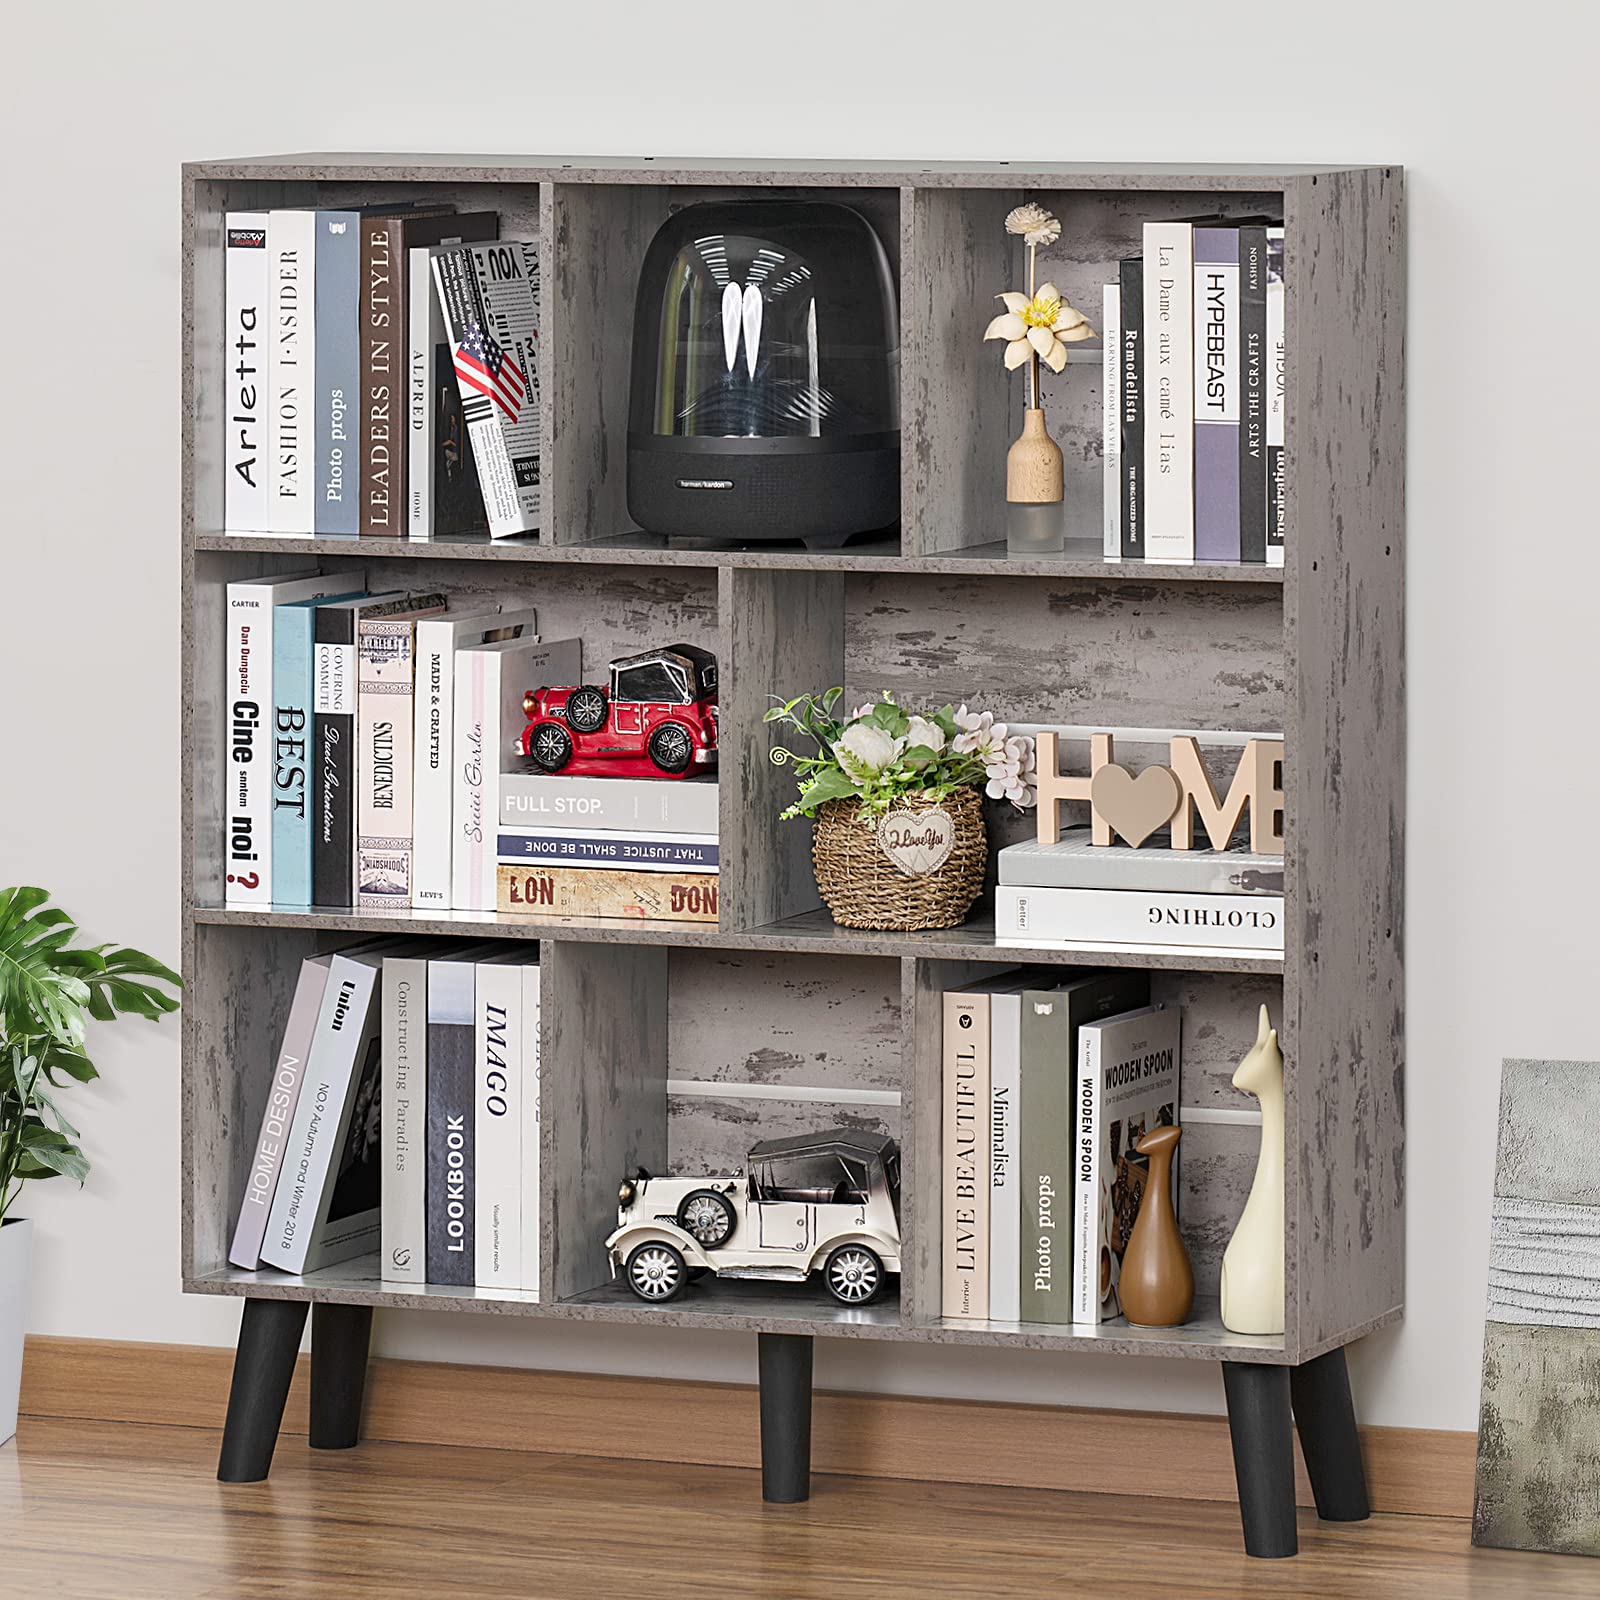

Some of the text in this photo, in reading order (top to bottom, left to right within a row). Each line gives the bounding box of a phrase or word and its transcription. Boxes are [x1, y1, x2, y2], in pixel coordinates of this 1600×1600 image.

[488, 247, 522, 280] YOU
[371, 230, 389, 526] LEADERS IN STYLE
[1125, 330, 1138, 422] Remodelista
[1159, 245, 1175, 475] La Dame aux camé lias
[1207, 273, 1225, 413] HYPEBEAST
[233, 307, 256, 488] Arletta
[413, 351, 425, 430] ALPRED
[1108, 330, 1116, 469] LEARNING FROM LAS VEGAS
[1249, 333, 1259, 458] ARTS THE CRAFTS
[279, 386, 298, 499] FASHION
[327, 389, 347, 502] Photo props
[1129, 522, 1137, 543] HOME
[1272, 451, 1285, 537] inspiration
[231, 600, 260, 608] CARTIER
[240, 626, 251, 694] Dan Dungaciu
[320, 646, 329, 709] COMMUTE
[334, 647, 343, 711] COVERING
[232, 701, 259, 763] Cine
[430, 653, 441, 770] MADE & CRAFTED
[463, 721, 482, 787] Garden
[274, 706, 306, 820] BEST
[373, 721, 393, 809] BENEDICTINS
[506, 796, 604, 814] FULL STOP.
[231, 816, 258, 861] noi
[525, 840, 704, 860] THAT JUSTICE SHALL BE DONE
[509, 876, 554, 905] LON
[671, 885, 718, 915] DON
[1019, 899, 1028, 928] Better
[1147, 906, 1276, 929] CLOTHING
[331, 979, 356, 1032] Union
[395, 981, 410, 1172] Constructing Paradies
[486, 1002, 508, 1117] IMAGO
[1104, 1048, 1174, 1091] WOODEN SPOON
[249, 1142, 279, 1205] HOME
[281, 1082, 330, 1250] NO.9 Autumn and Winter 2018
[993, 1086, 1009, 1188] Minimalista
[1080, 1078, 1093, 1183] WOODEN SPOON
[447, 1114, 464, 1252] LOOKBOOK
[492, 1204, 500, 1228] Visually
[956, 1044, 976, 1315] Interior LIVE BEAUTIFUL
[1035, 1174, 1055, 1292] Photo props
